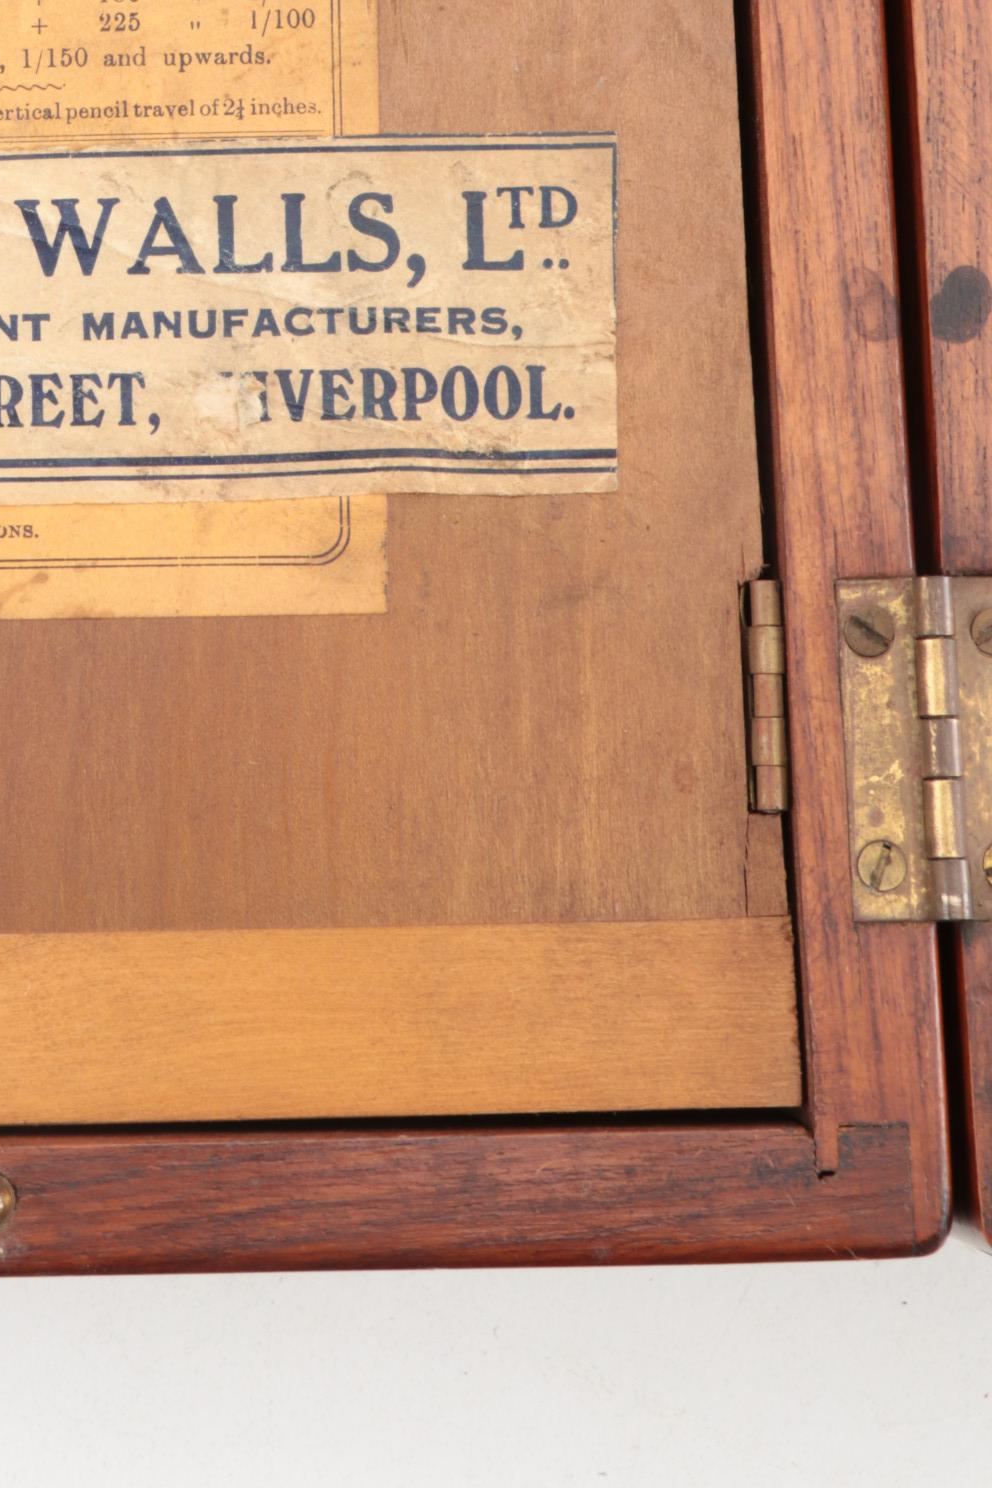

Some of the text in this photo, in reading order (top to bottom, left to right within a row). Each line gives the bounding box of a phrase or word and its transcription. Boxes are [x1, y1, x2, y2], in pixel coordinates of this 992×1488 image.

[99, 12, 140, 32] 225
[252, 8, 315, 37] 1/100
[23, 47, 88, 74] 1/150
[104, 46, 146, 67] and
[164, 44, 270, 73] upwards.
[66, 100, 128, 124] pencil
[134, 99, 194, 118] travel
[200, 99, 219, 116] of
[251, 97, 321, 117] inches.
[14, 192, 426, 288] WALLS,
[83, 307, 523, 340] MANUFACTURERS,
[217, 364, 575, 422] IVERPOOL.
